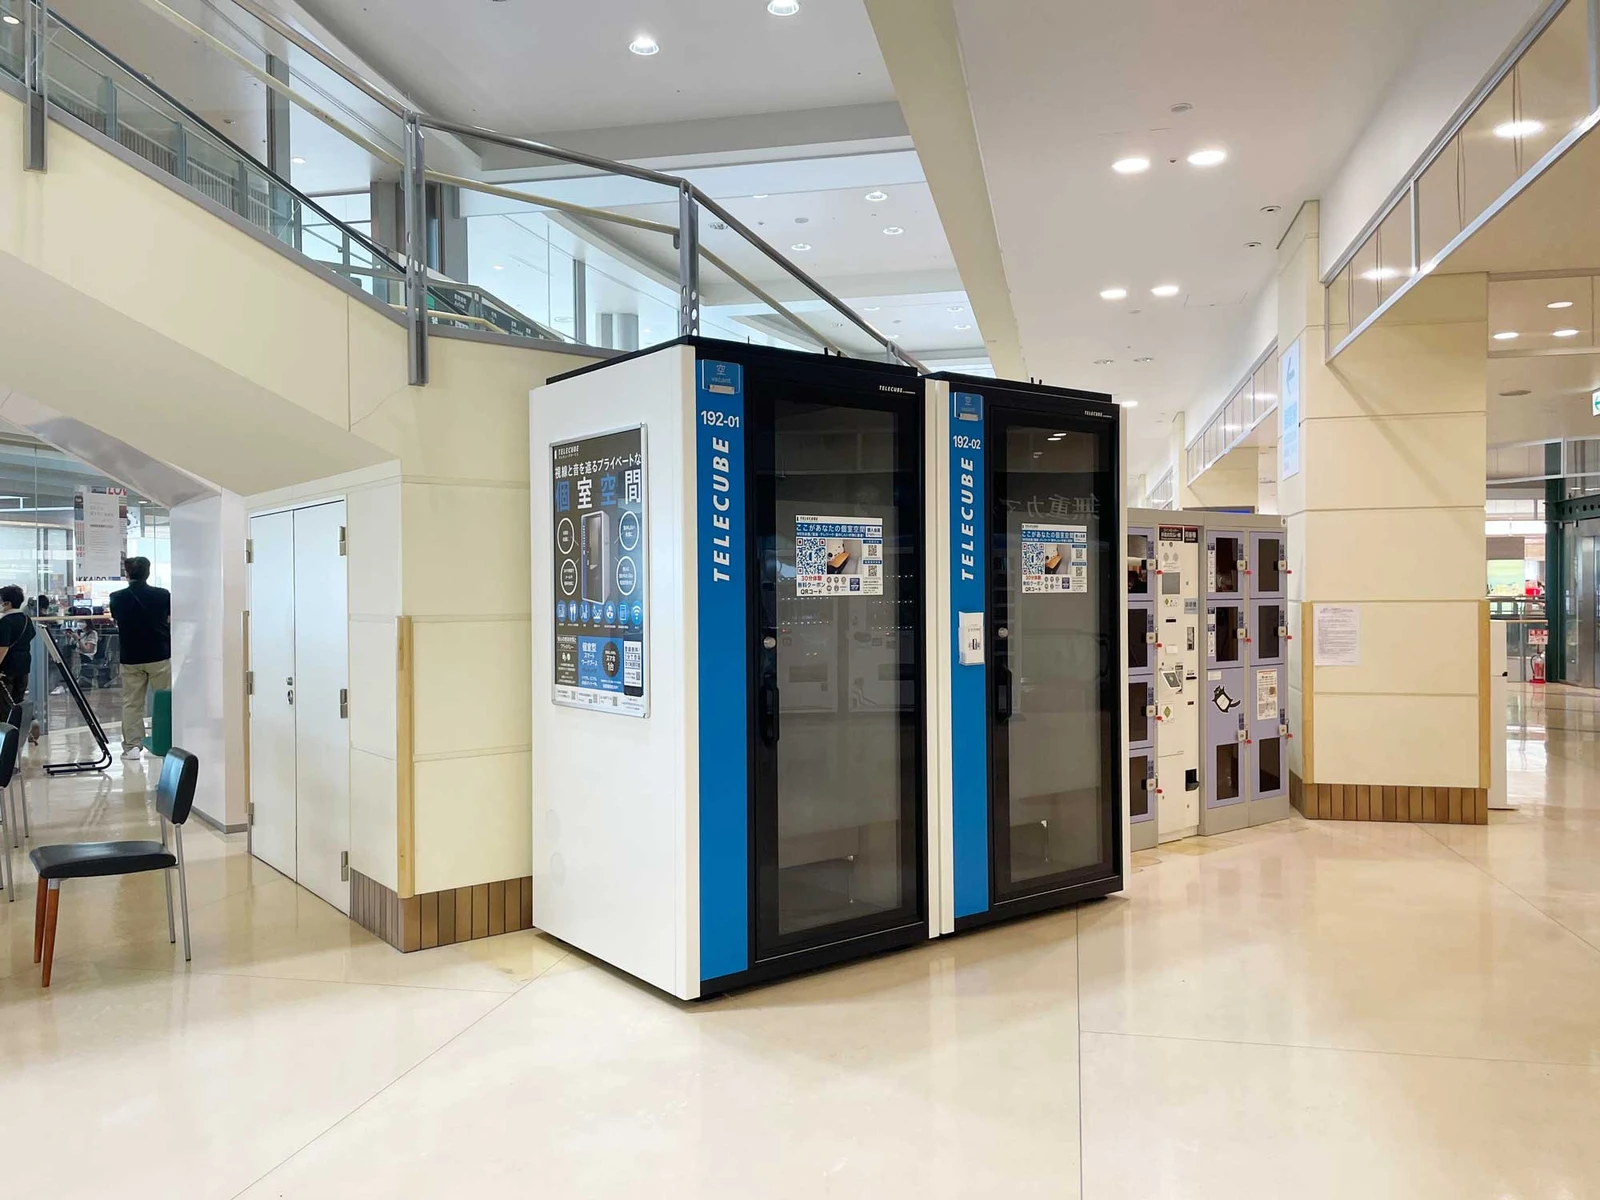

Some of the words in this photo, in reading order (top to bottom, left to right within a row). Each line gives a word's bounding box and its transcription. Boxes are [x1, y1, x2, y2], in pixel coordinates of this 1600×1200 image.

[701, 410, 740, 428] 192-01
[952, 435, 981, 450] 192-02
[555, 452, 642, 479] 視線と音を遮るプライベートな
[556, 468, 642, 513] 個室空間
[712, 437, 730, 582] TELECUBE
[960, 457, 974, 581] TELECUBE
[796, 524, 865, 533] ここがあなたの個室空間
